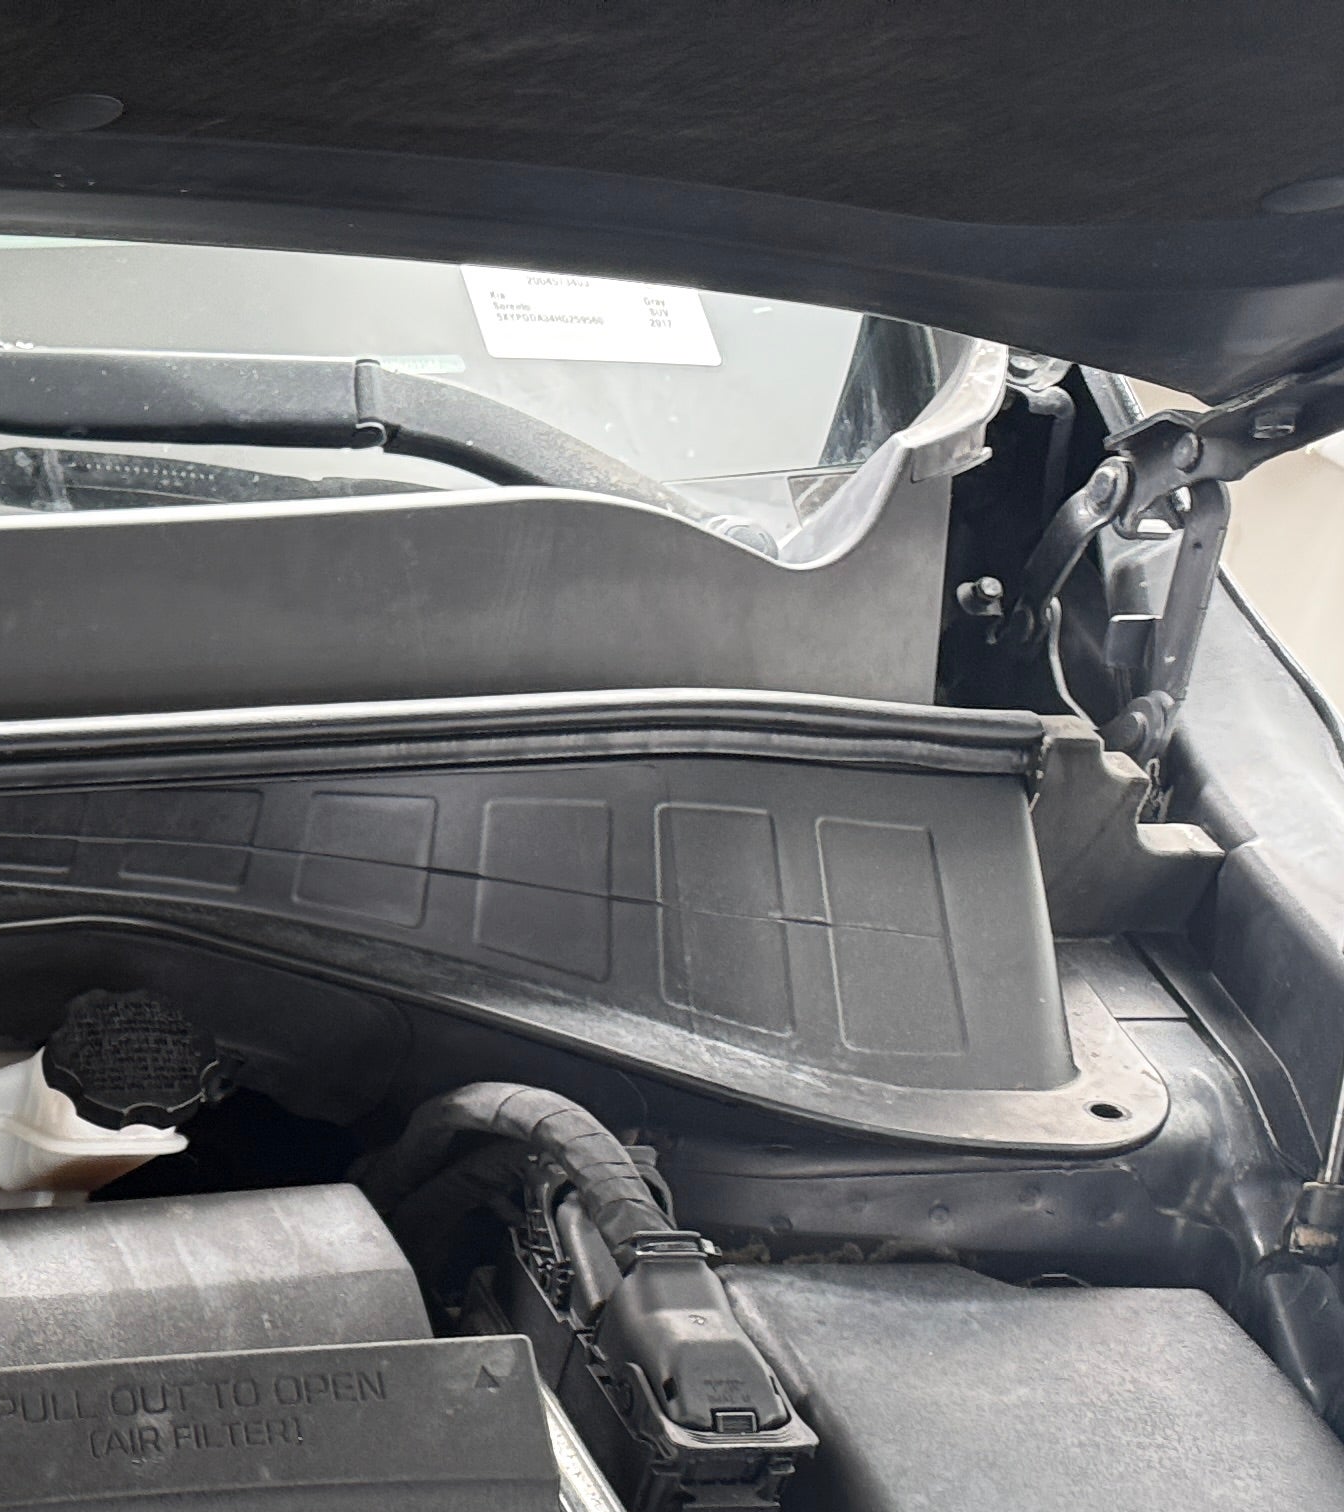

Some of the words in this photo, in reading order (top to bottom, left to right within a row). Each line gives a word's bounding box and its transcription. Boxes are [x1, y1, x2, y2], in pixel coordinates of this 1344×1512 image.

[649, 308, 669, 317] SUV
[111, 1383, 193, 1419] OUT
[211, 1380, 263, 1410] TO
[273, 1370, 388, 1405] OPEN
